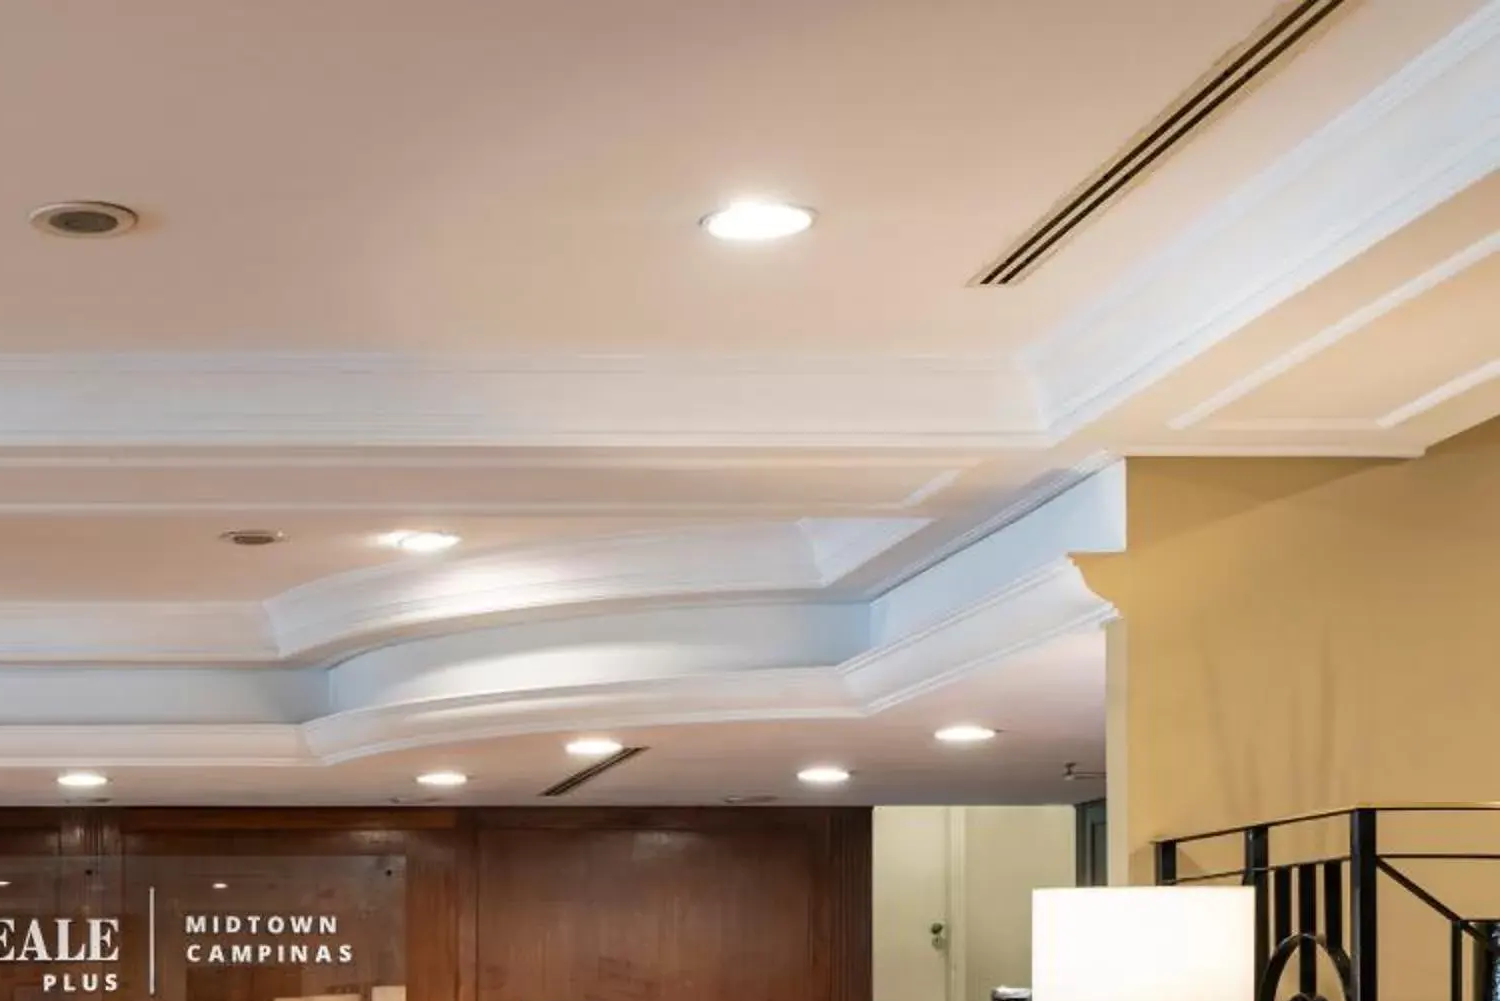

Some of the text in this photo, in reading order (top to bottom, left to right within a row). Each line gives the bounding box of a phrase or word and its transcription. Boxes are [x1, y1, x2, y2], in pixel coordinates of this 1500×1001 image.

[186, 915, 337, 935] MIDTOWN
[187, 944, 352, 963] CAMPINAS
[43, 973, 118, 992] PLUS
